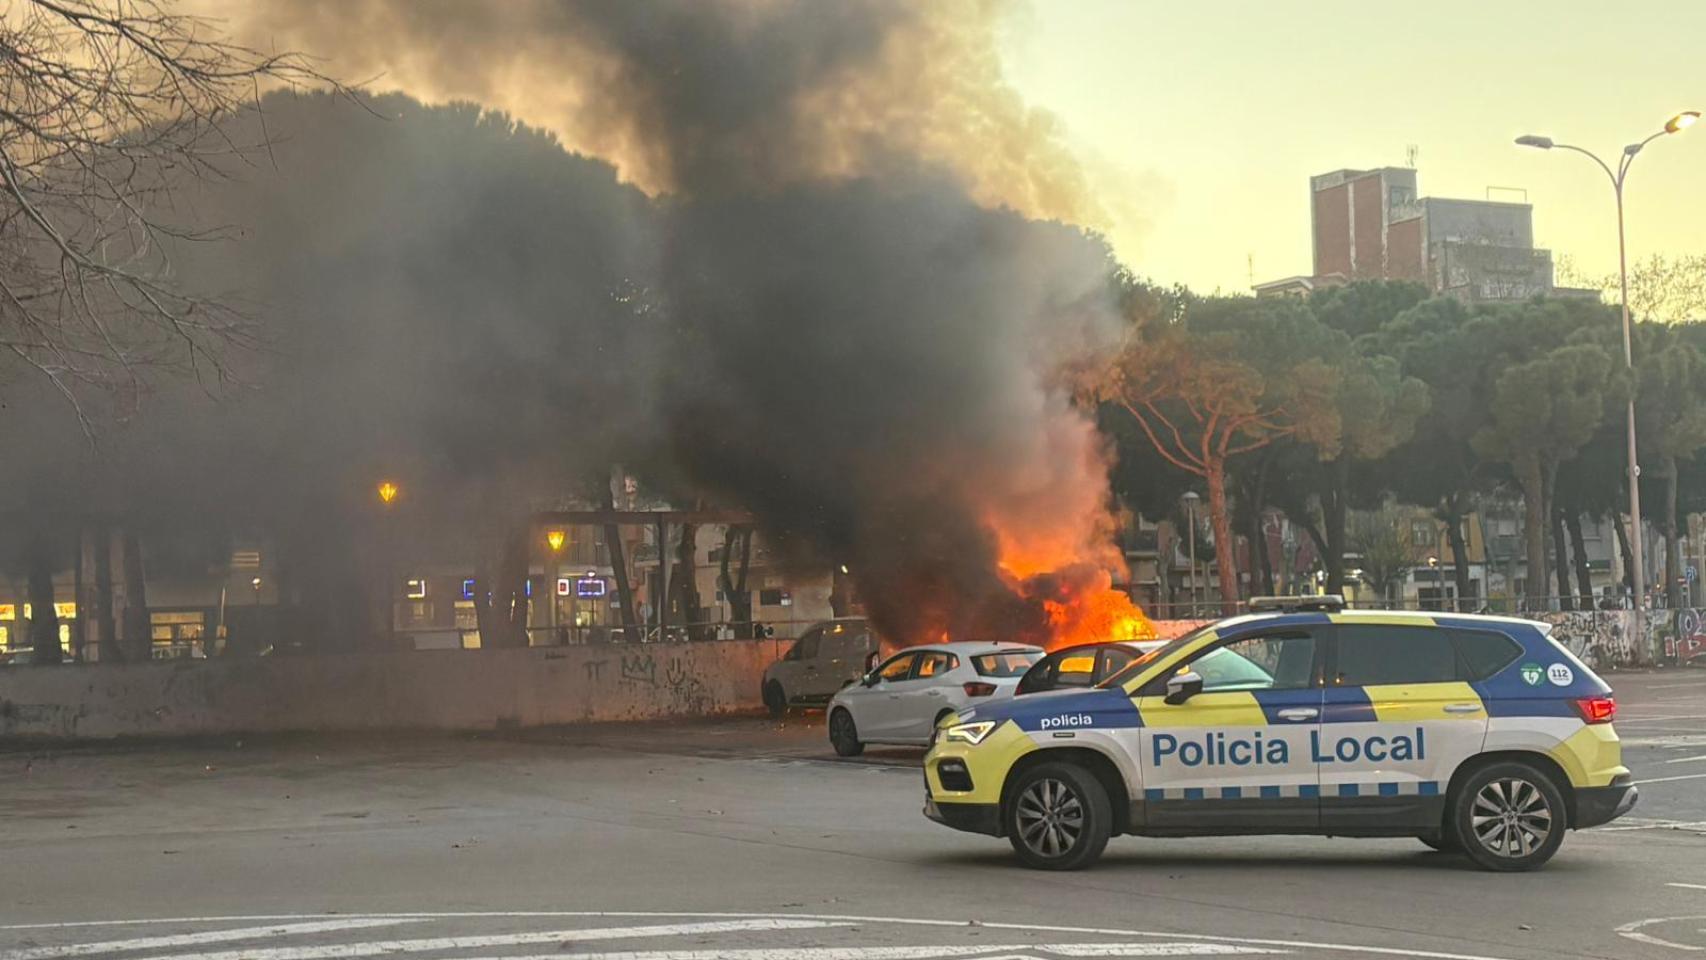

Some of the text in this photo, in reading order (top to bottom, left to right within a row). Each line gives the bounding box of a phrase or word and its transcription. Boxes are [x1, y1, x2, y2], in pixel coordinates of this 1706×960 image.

[1551, 668, 1568, 678] 112
[1040, 713, 1092, 730] policia
[1152, 727, 1425, 767] Policia Local
